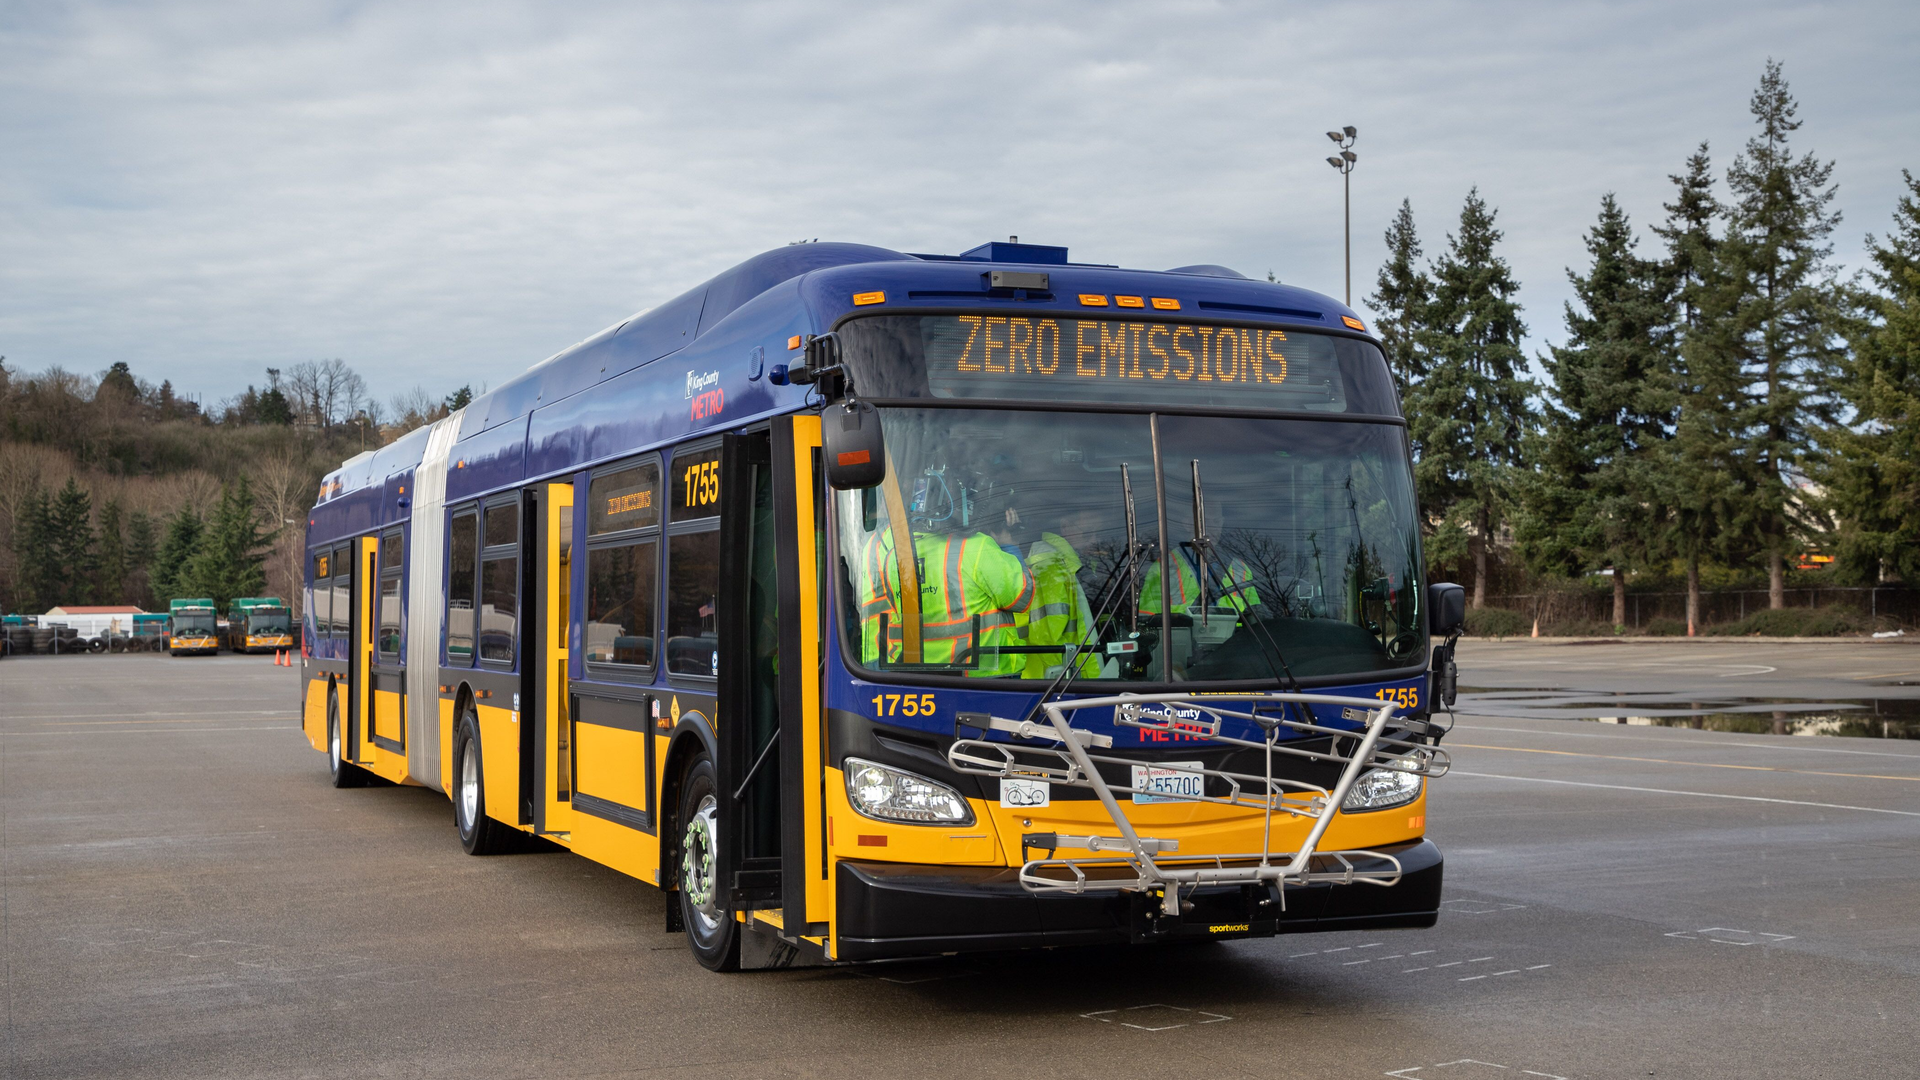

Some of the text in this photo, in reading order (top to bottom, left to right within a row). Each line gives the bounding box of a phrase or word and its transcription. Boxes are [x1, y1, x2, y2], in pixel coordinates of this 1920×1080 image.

[958, 315, 1287, 384] ZERO EMISSIONS
[693, 370, 720, 391] King County
[690, 387, 724, 422] METRO
[684, 461, 719, 507] 1755
[871, 693, 936, 717] 1755
[1375, 687, 1419, 709] 1755
[1209, 923, 1249, 934] sportworks
